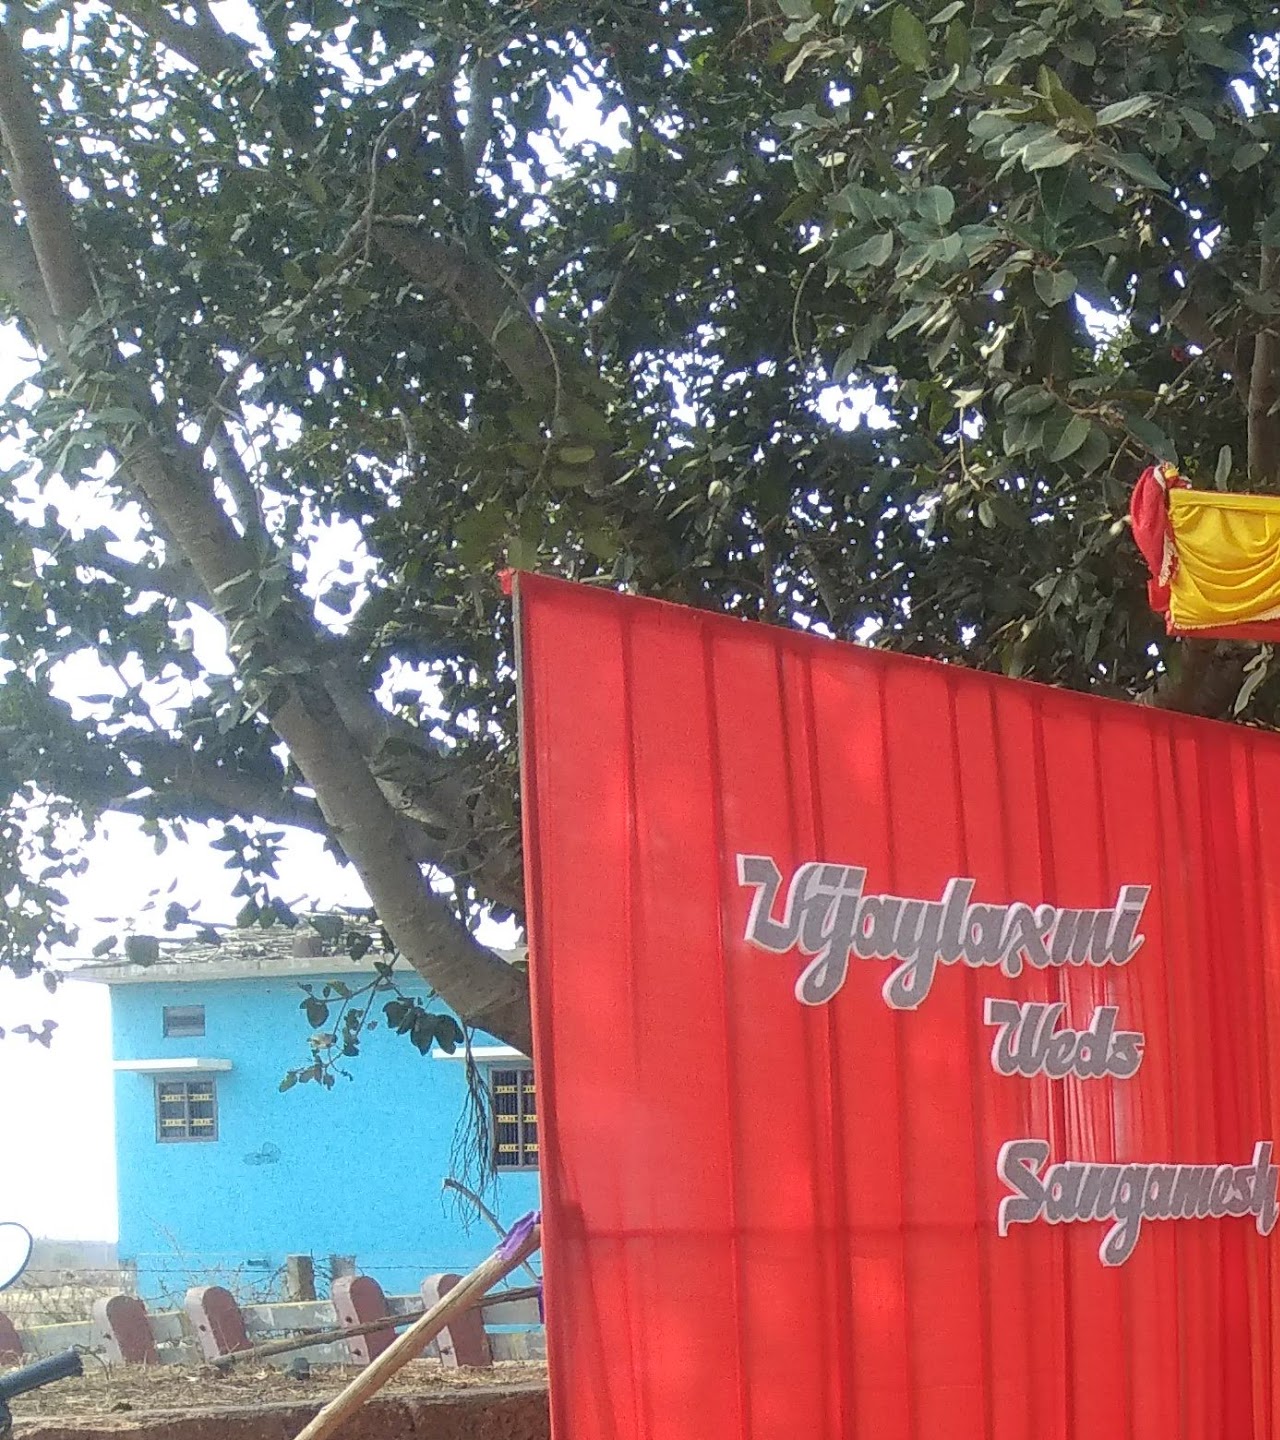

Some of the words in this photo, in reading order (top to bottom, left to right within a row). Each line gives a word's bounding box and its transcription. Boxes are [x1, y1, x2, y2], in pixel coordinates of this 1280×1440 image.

[737, 853, 1152, 1010] Vijaylaxmi
[984, 998, 1146, 1079] Weds
[997, 1139, 1280, 1267] Sangamesh
